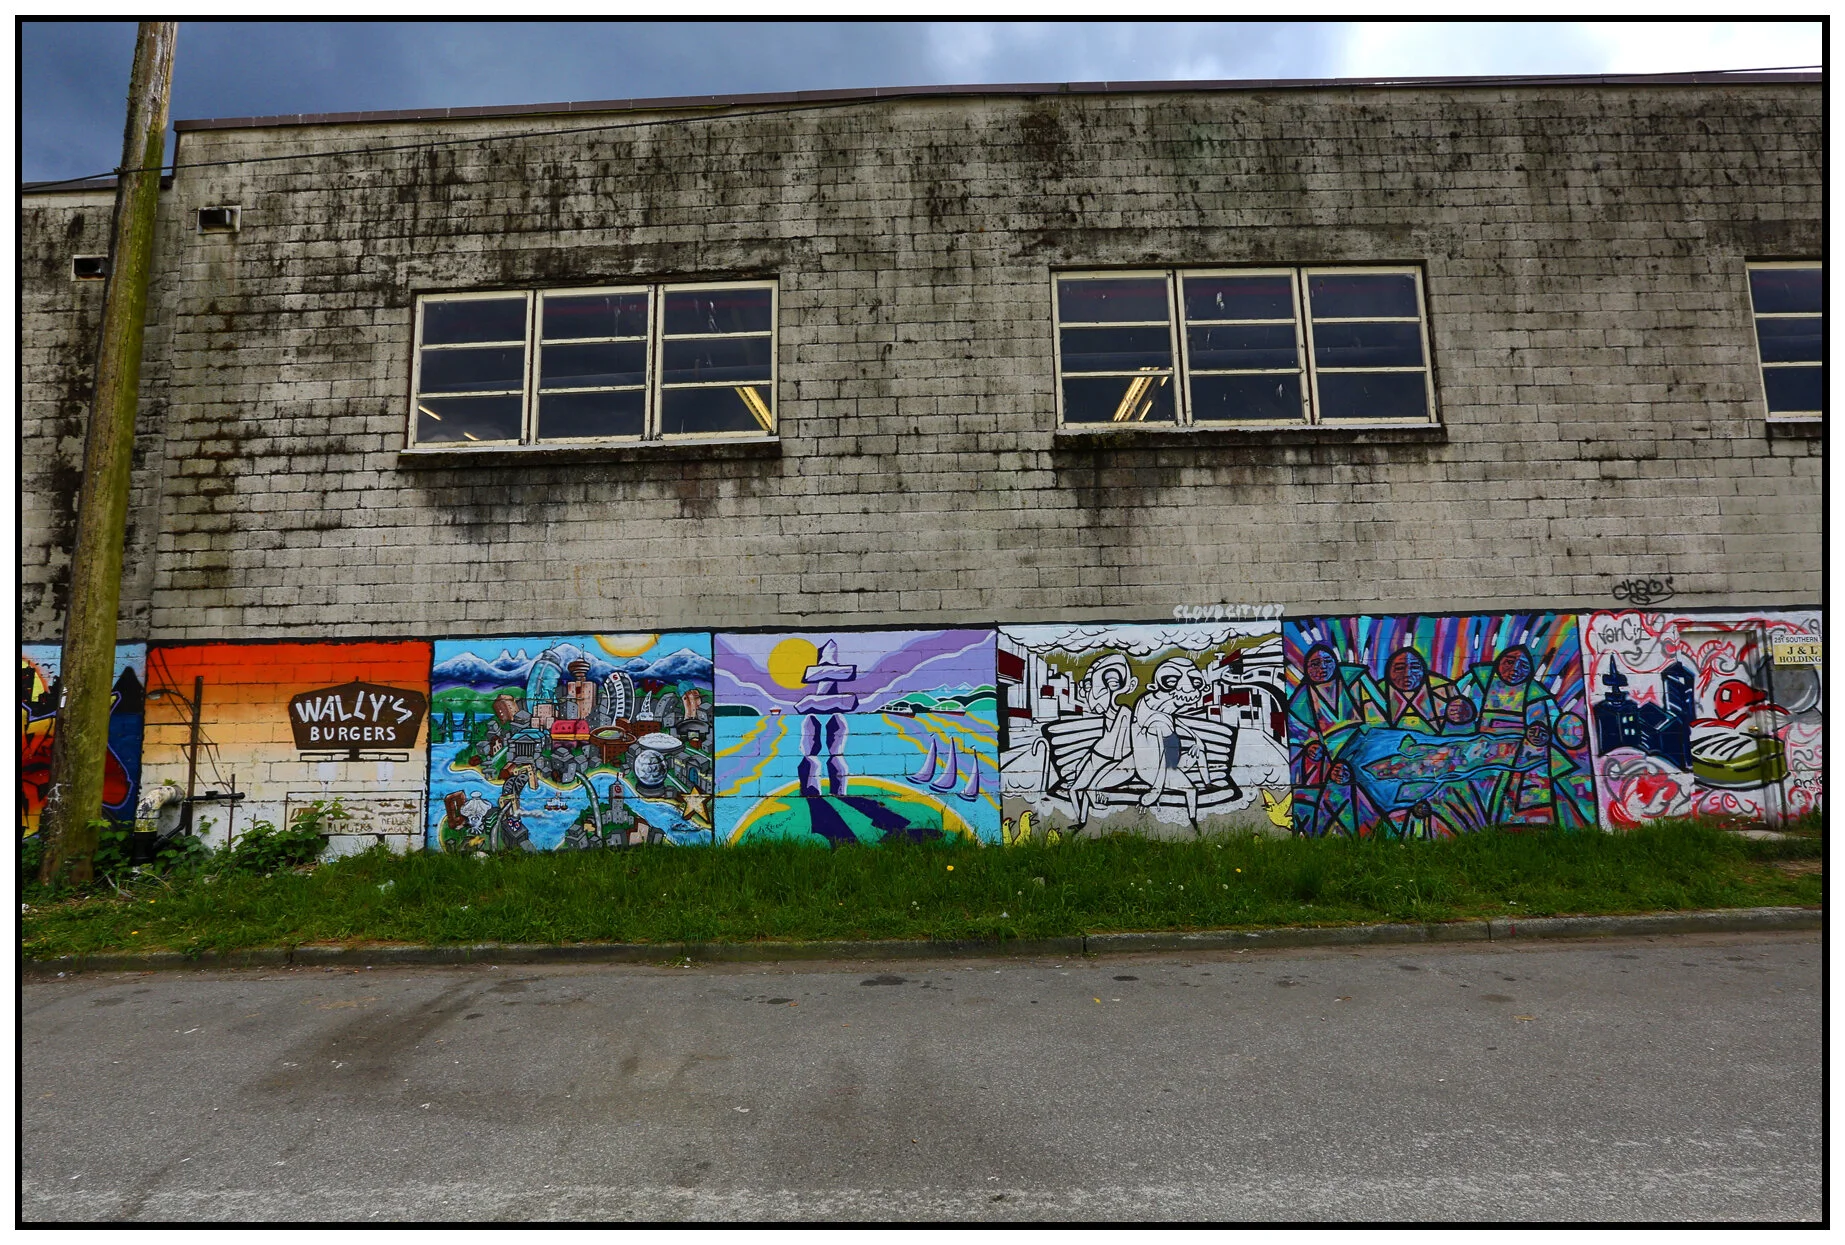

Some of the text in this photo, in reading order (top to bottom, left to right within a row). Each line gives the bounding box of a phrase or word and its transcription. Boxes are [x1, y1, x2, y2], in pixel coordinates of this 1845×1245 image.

[1787, 646, 1818, 655] J & L
[295, 690, 413, 724] WALLY'S
[310, 726, 396, 741] BURGERS
